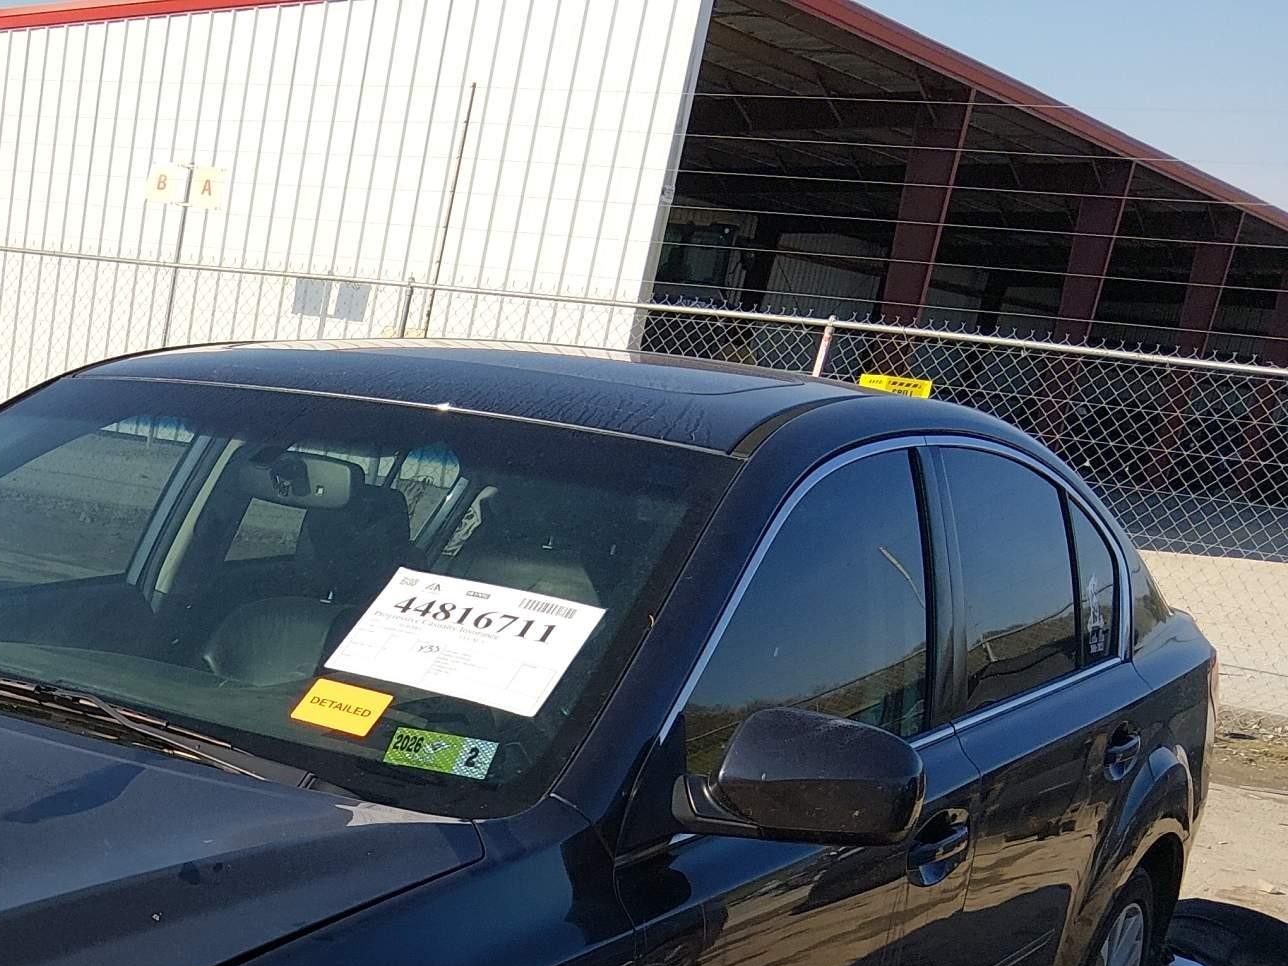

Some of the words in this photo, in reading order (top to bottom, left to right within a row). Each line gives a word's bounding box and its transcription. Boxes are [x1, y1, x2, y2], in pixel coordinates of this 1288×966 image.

[156, 174, 167, 191] B
[201, 179, 212, 197] A
[393, 596, 557, 643] 44816711
[309, 695, 372, 719] DETAILED
[392, 733, 425, 753] 2026
[463, 746, 480, 768] 2
